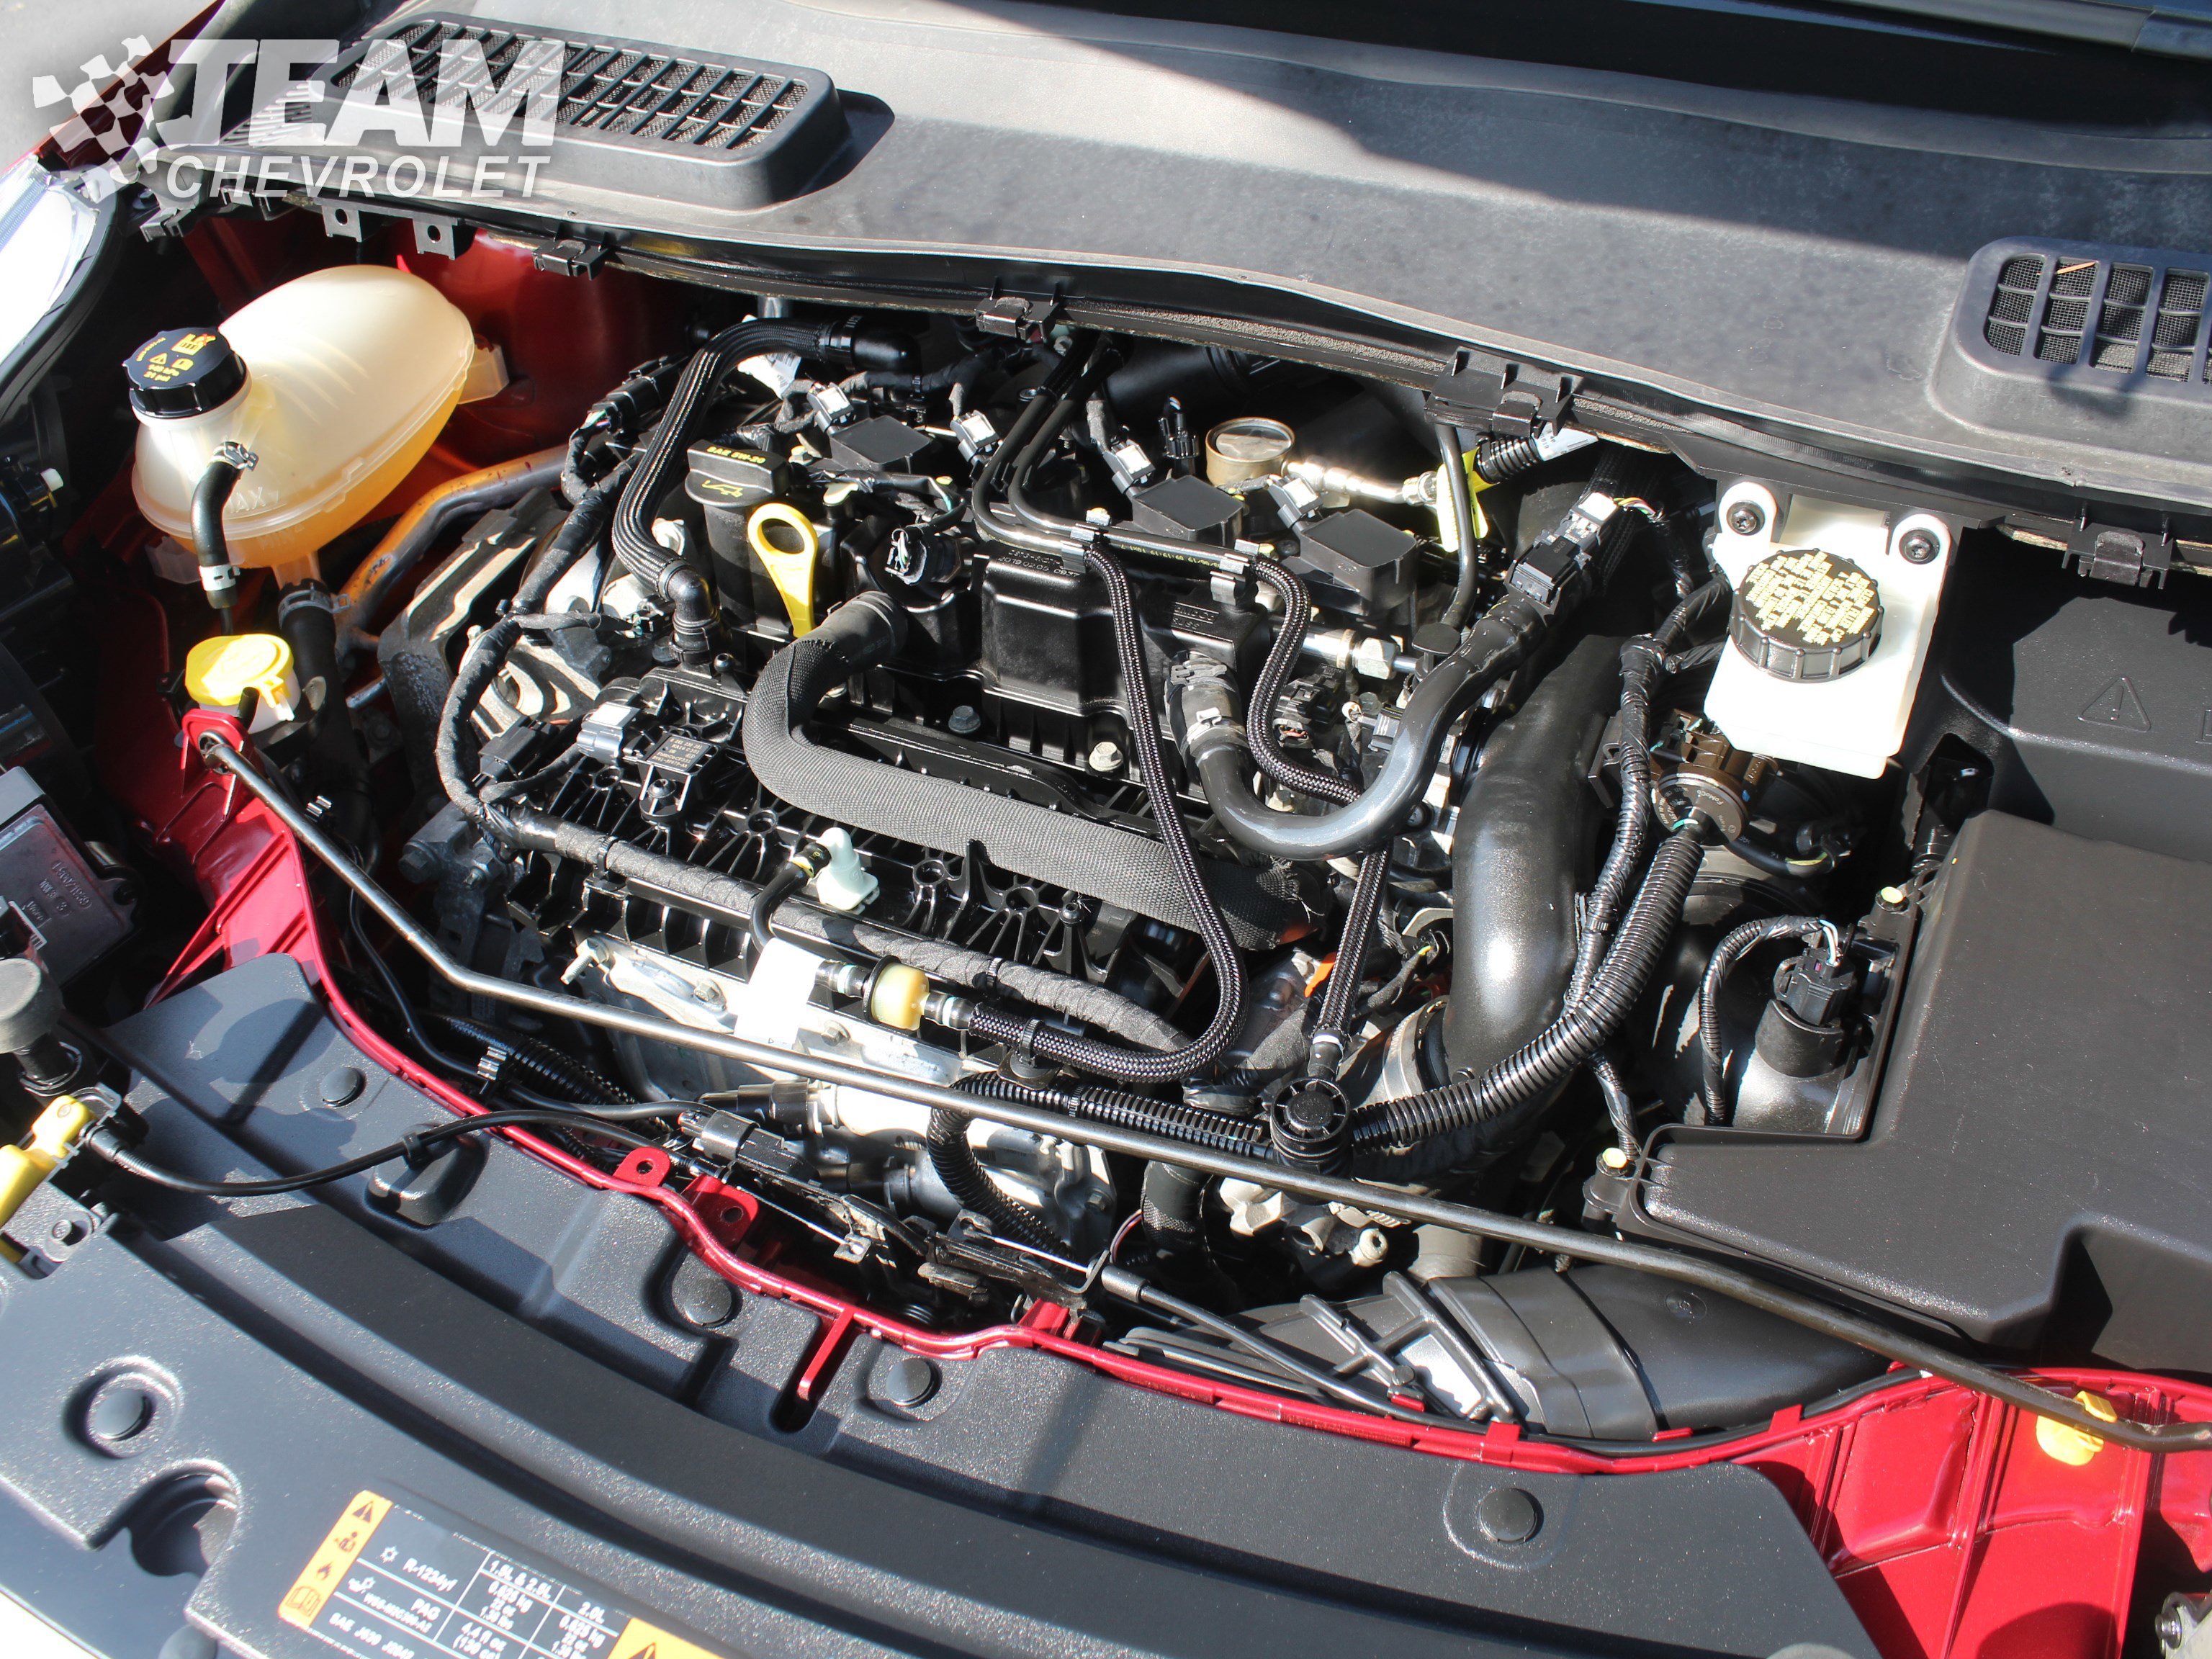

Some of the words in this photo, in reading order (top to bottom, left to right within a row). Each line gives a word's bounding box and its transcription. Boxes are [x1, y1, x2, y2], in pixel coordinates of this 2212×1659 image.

[706, 446, 732, 457] SAE
[731, 451, 766, 464] 5W-20
[1696, 789, 1724, 806] FoMoCo
[403, 1557, 459, 1593] R-1234yf
[411, 1598, 442, 1622] PAG
[516, 1593, 534, 1614] kg
[577, 1601, 606, 1625] 2.0L
[328, 1612, 356, 1633] SAE
[461, 1622, 483, 1640] 4.4
[588, 1629, 606, 1650] kg
